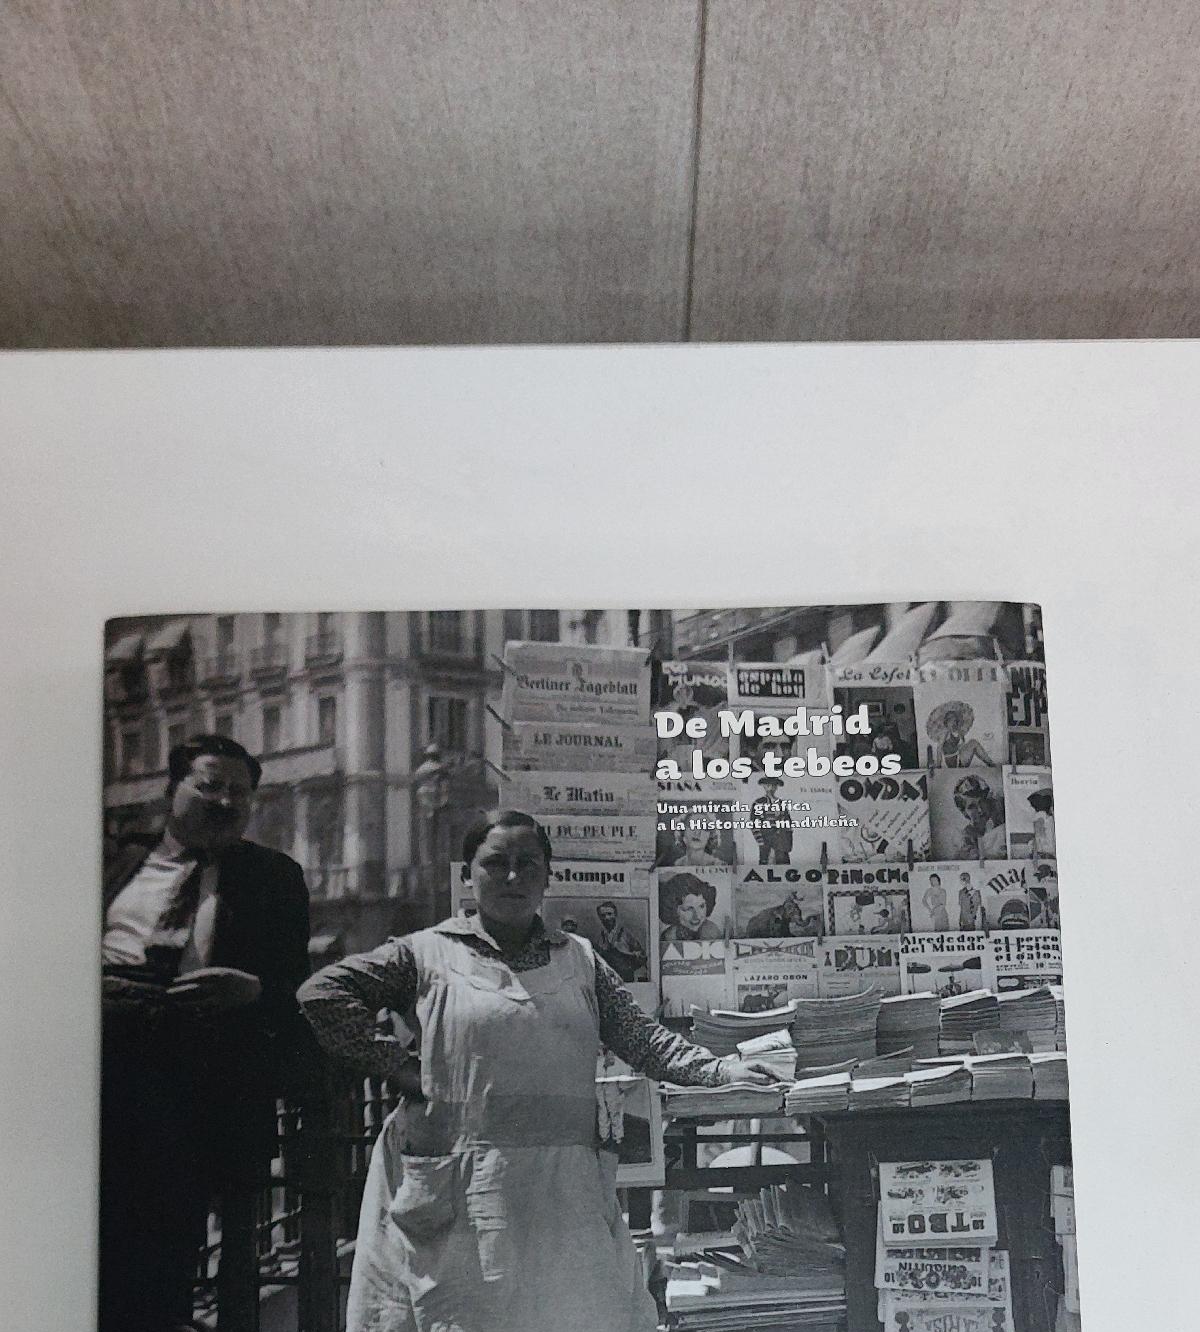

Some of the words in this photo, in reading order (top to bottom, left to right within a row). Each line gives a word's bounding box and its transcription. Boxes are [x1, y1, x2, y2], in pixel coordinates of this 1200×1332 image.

[516, 673, 571, 691] Berliner
[654, 711, 707, 739] De
[717, 705, 872, 738] Madrid
[533, 733, 551, 746] LE
[555, 734, 623, 748] JOURNAL
[655, 758, 682, 780] a
[692, 749, 752, 780] los
[762, 748, 902, 778] tebeos
[565, 787, 615, 802] Matin
[656, 802, 689, 814] Una
[692, 801, 751, 814] mirada
[754, 799, 811, 816] gráfica
[657, 822, 667, 831] a
[670, 819, 686, 831] la
[689, 818, 773, 831] Historieta
[776, 816, 859, 829] madrileña
[583, 825, 638, 838] PEUPLE
[550, 868, 625, 884] stampa
[743, 869, 823, 882] ALGO
[901, 935, 984, 945] Alrededor
[901, 943, 920, 954] del
[932, 942, 985, 953] Mundo
[907, 1212, 970, 1234] TBO
[884, 1272, 895, 1284] 10
